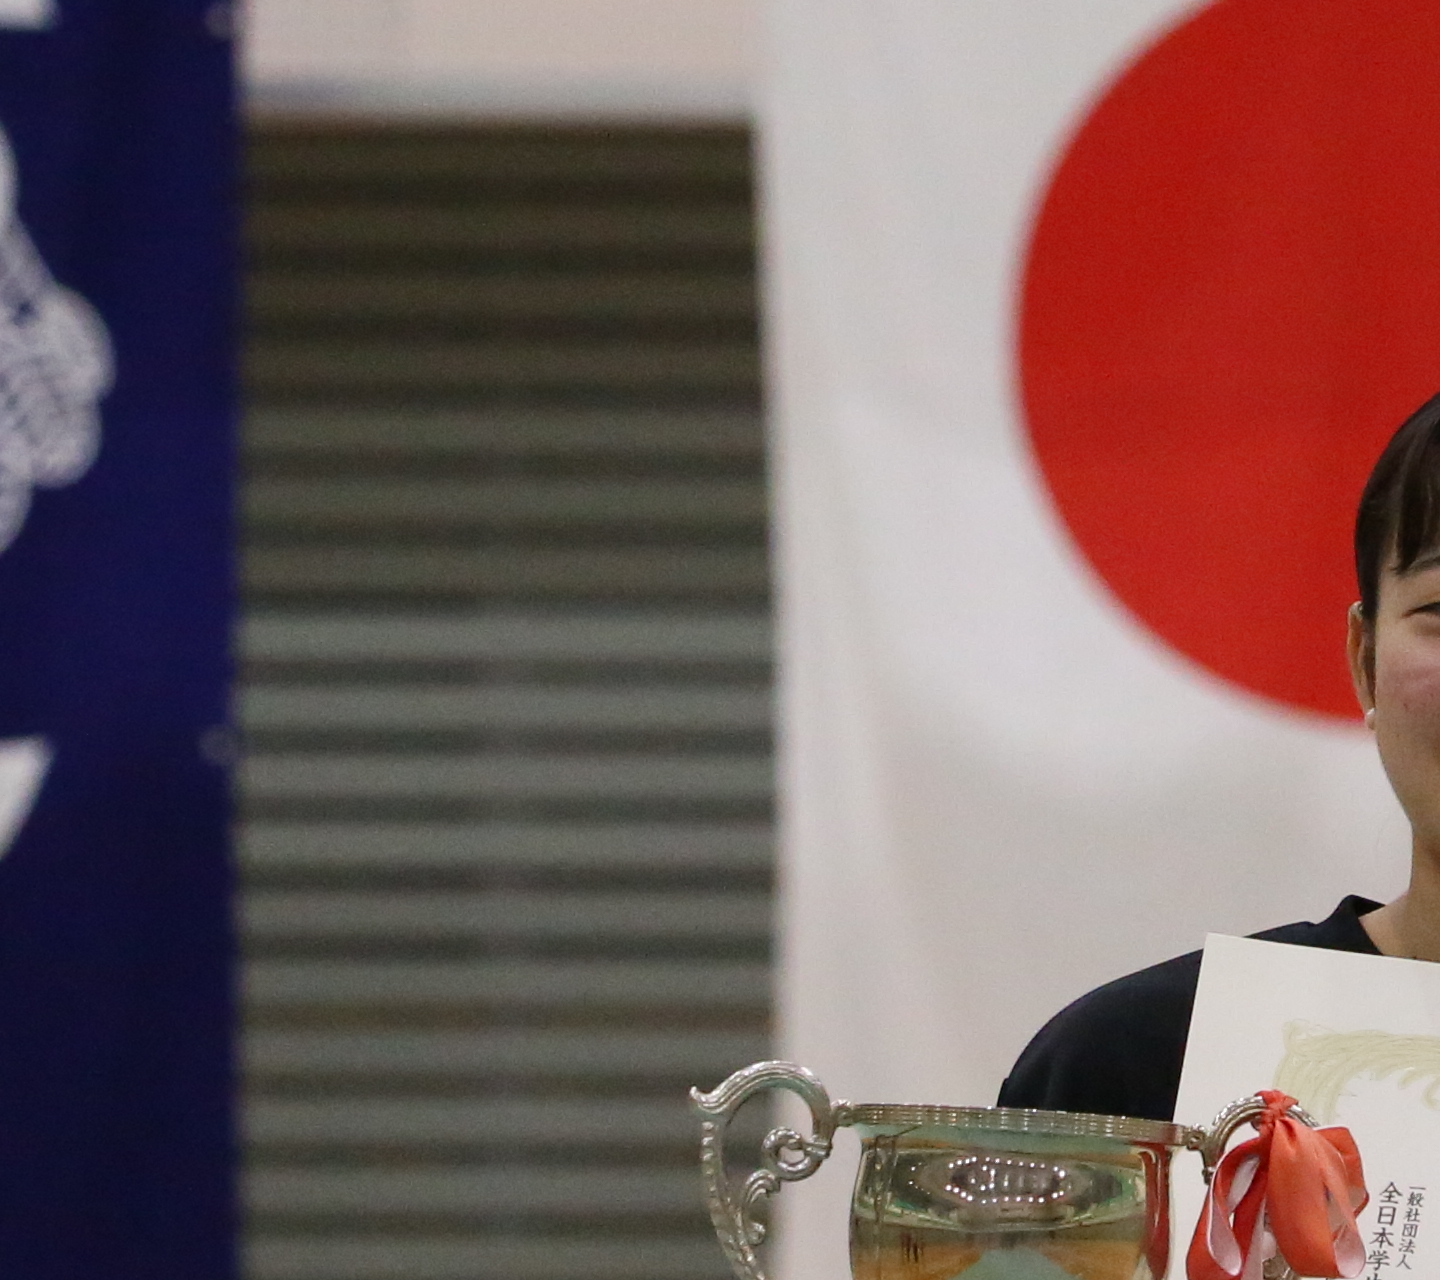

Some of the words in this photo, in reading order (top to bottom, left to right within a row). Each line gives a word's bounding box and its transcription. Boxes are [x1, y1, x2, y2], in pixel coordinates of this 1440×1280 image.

[1396, 1186, 1427, 1270] 一般社団法人
